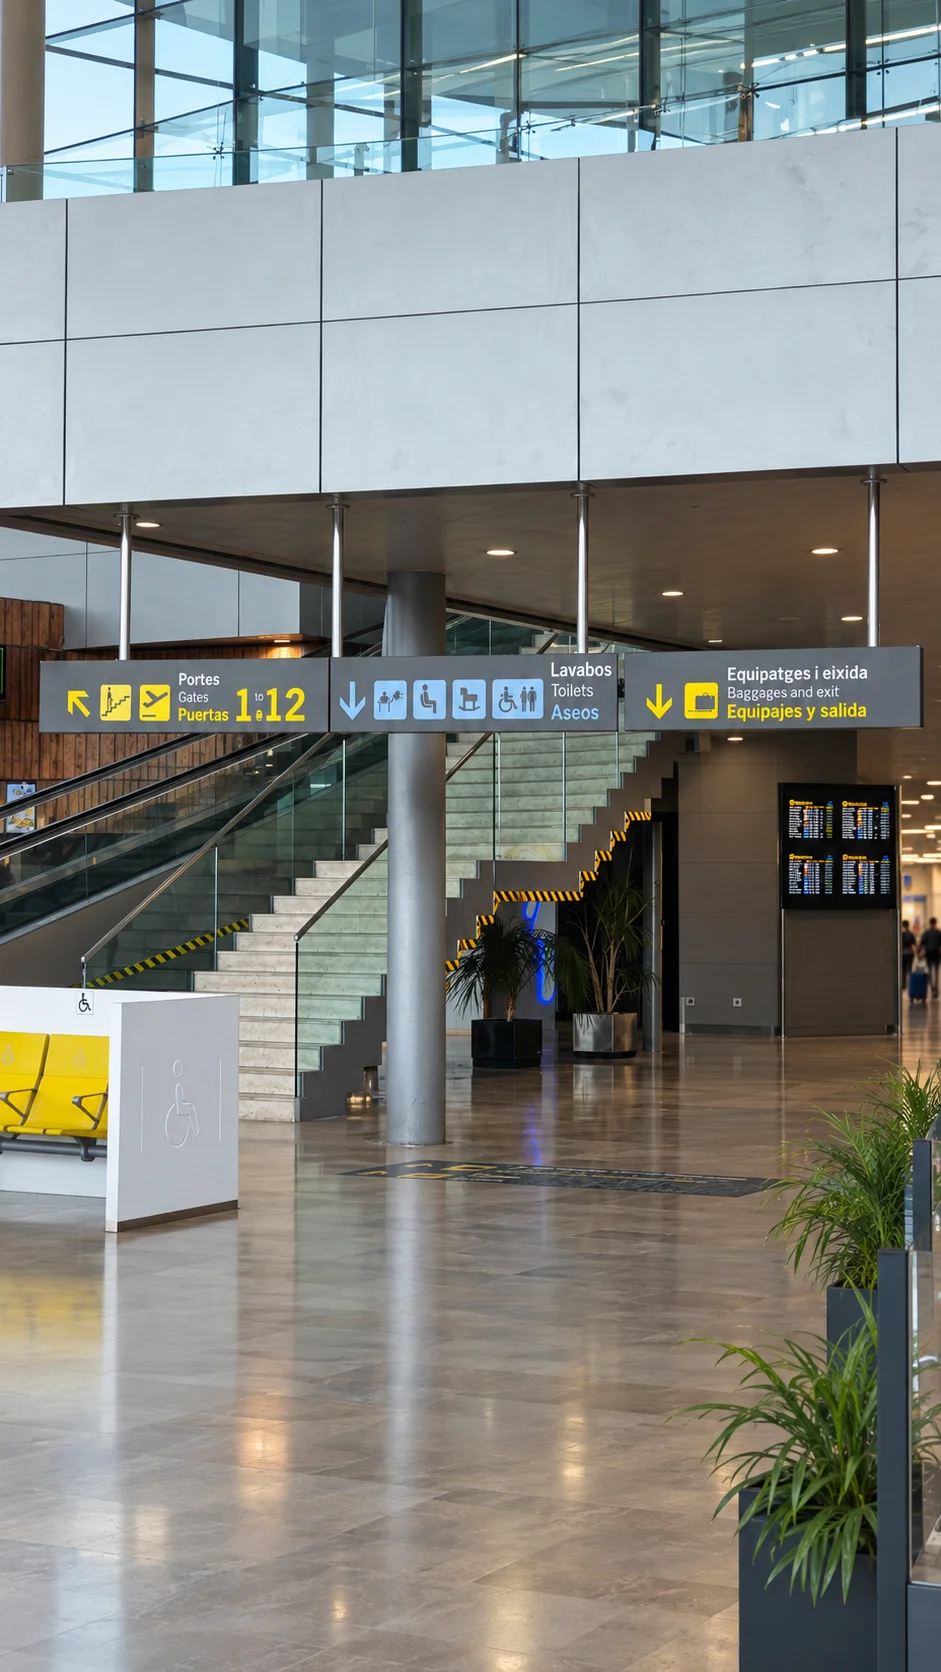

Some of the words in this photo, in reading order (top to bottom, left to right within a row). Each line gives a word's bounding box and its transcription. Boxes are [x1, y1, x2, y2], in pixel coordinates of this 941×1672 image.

[551, 661, 612, 677] Lavabos
[727, 667, 811, 684] Equipatges
[815, 666, 819, 680] i
[823, 664, 868, 680] eixida
[178, 672, 220, 686] Portes
[178, 690, 209, 703] Gates
[551, 683, 594, 697] Toilets
[727, 687, 788, 701] Baggages
[791, 685, 813, 698] and
[816, 686, 840, 698] exit
[236, 688, 252, 722] 1
[254, 692, 264, 702] to
[265, 687, 306, 722] 12
[551, 704, 599, 720] Aseos
[727, 704, 802, 721] Equipajes
[806, 706, 816, 721] y
[820, 702, 867, 718] salida
[178, 707, 229, 721] Puertas
